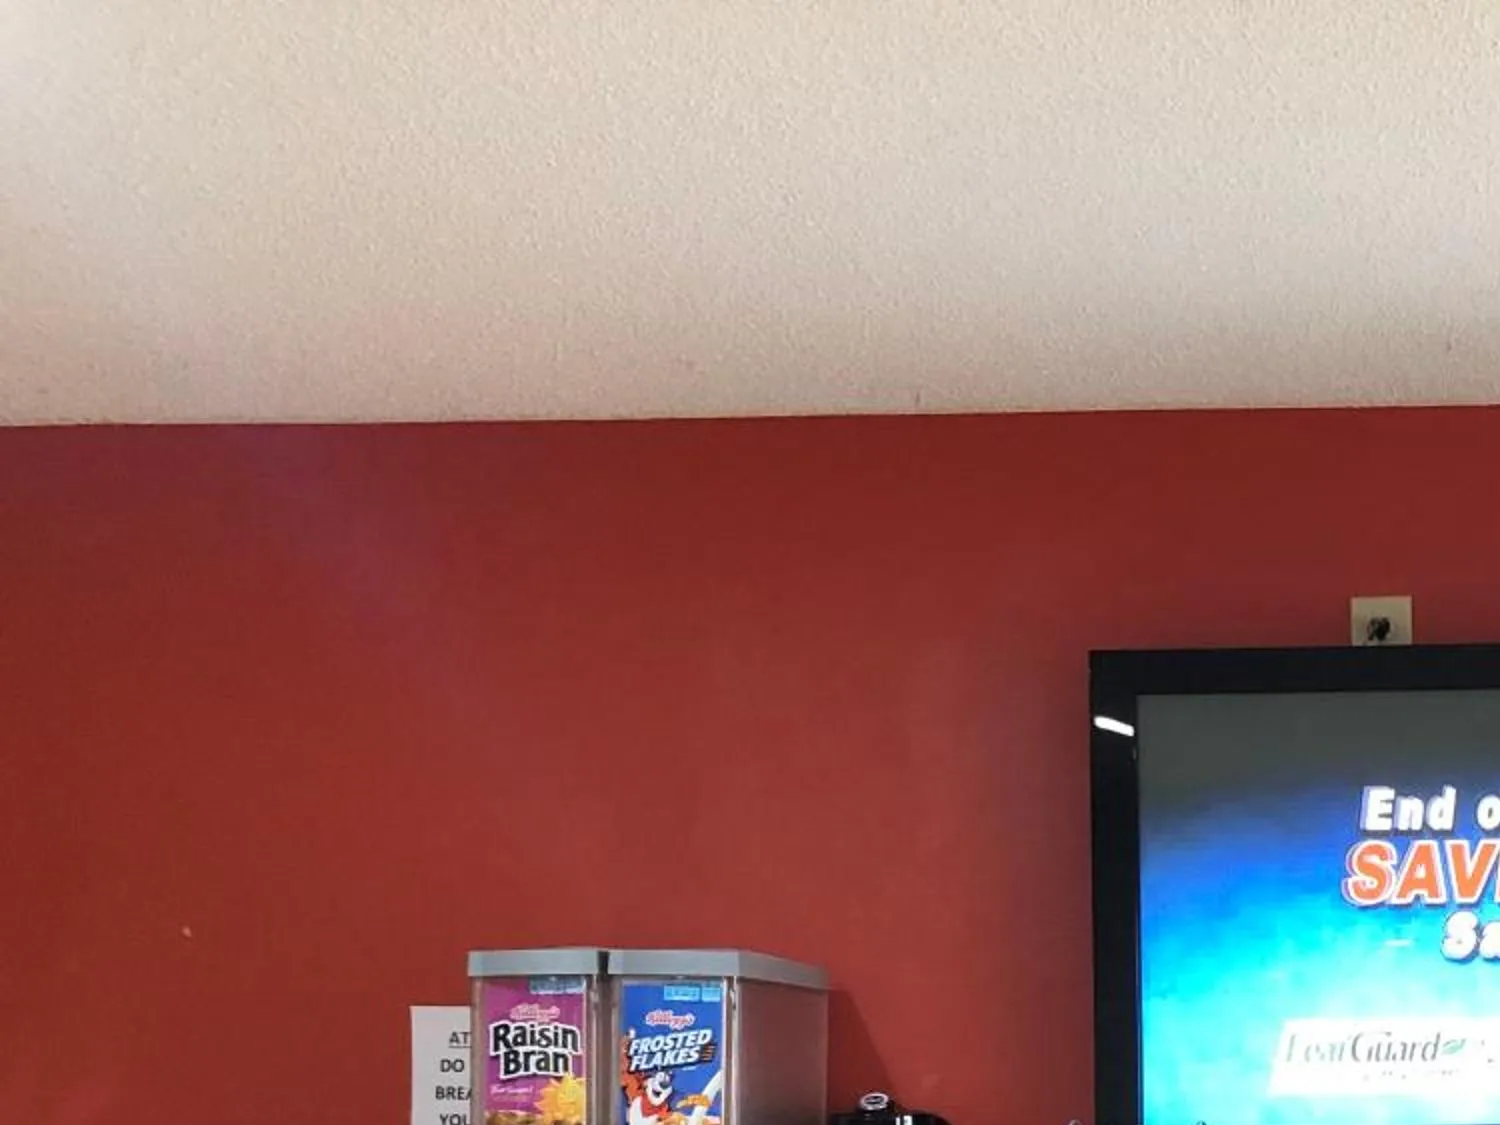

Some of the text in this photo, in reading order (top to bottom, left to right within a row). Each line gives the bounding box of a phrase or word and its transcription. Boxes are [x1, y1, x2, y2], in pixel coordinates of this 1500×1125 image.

[1360, 785, 1456, 831] End
[491, 1022, 579, 1054] Raisin
[629, 1029, 713, 1057] FROSTED
[440, 1059, 464, 1073] DO
[503, 1049, 570, 1077] Bran
[630, 1046, 700, 1072] FLAKES
